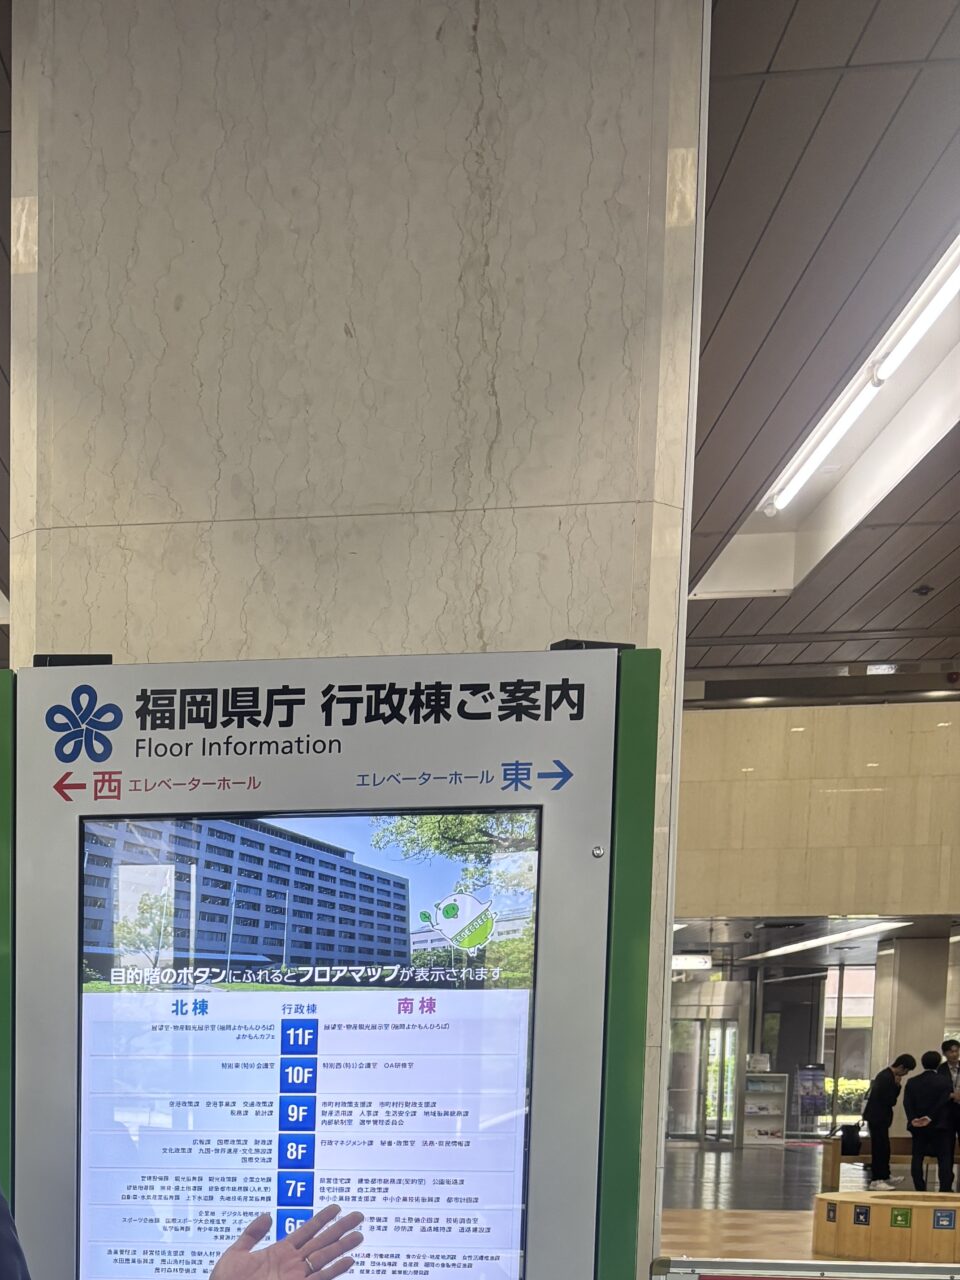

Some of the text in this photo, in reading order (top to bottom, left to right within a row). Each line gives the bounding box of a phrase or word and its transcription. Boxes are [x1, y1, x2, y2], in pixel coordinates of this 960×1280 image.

[135, 678, 585, 730] 福岡県庁 行政棟ご案内
[136, 734, 342, 759] Floor Information
[93, 771, 261, 799] 西 エレベーターホール
[355, 761, 533, 791] エレベーターホール 東
[110, 964, 503, 985] 目的階のボタンにふれるとフロアマップが表示されます
[171, 998, 209, 1016] 北棟
[281, 1003, 317, 1015] 行政棟
[397, 997, 437, 1014] 南棟
[286, 1028, 313, 1045] 11F
[285, 1067, 312, 1083] 10F
[288, 1104, 308, 1122] 9F
[287, 1143, 307, 1159] 8F
[286, 1180, 305, 1197] 7F
